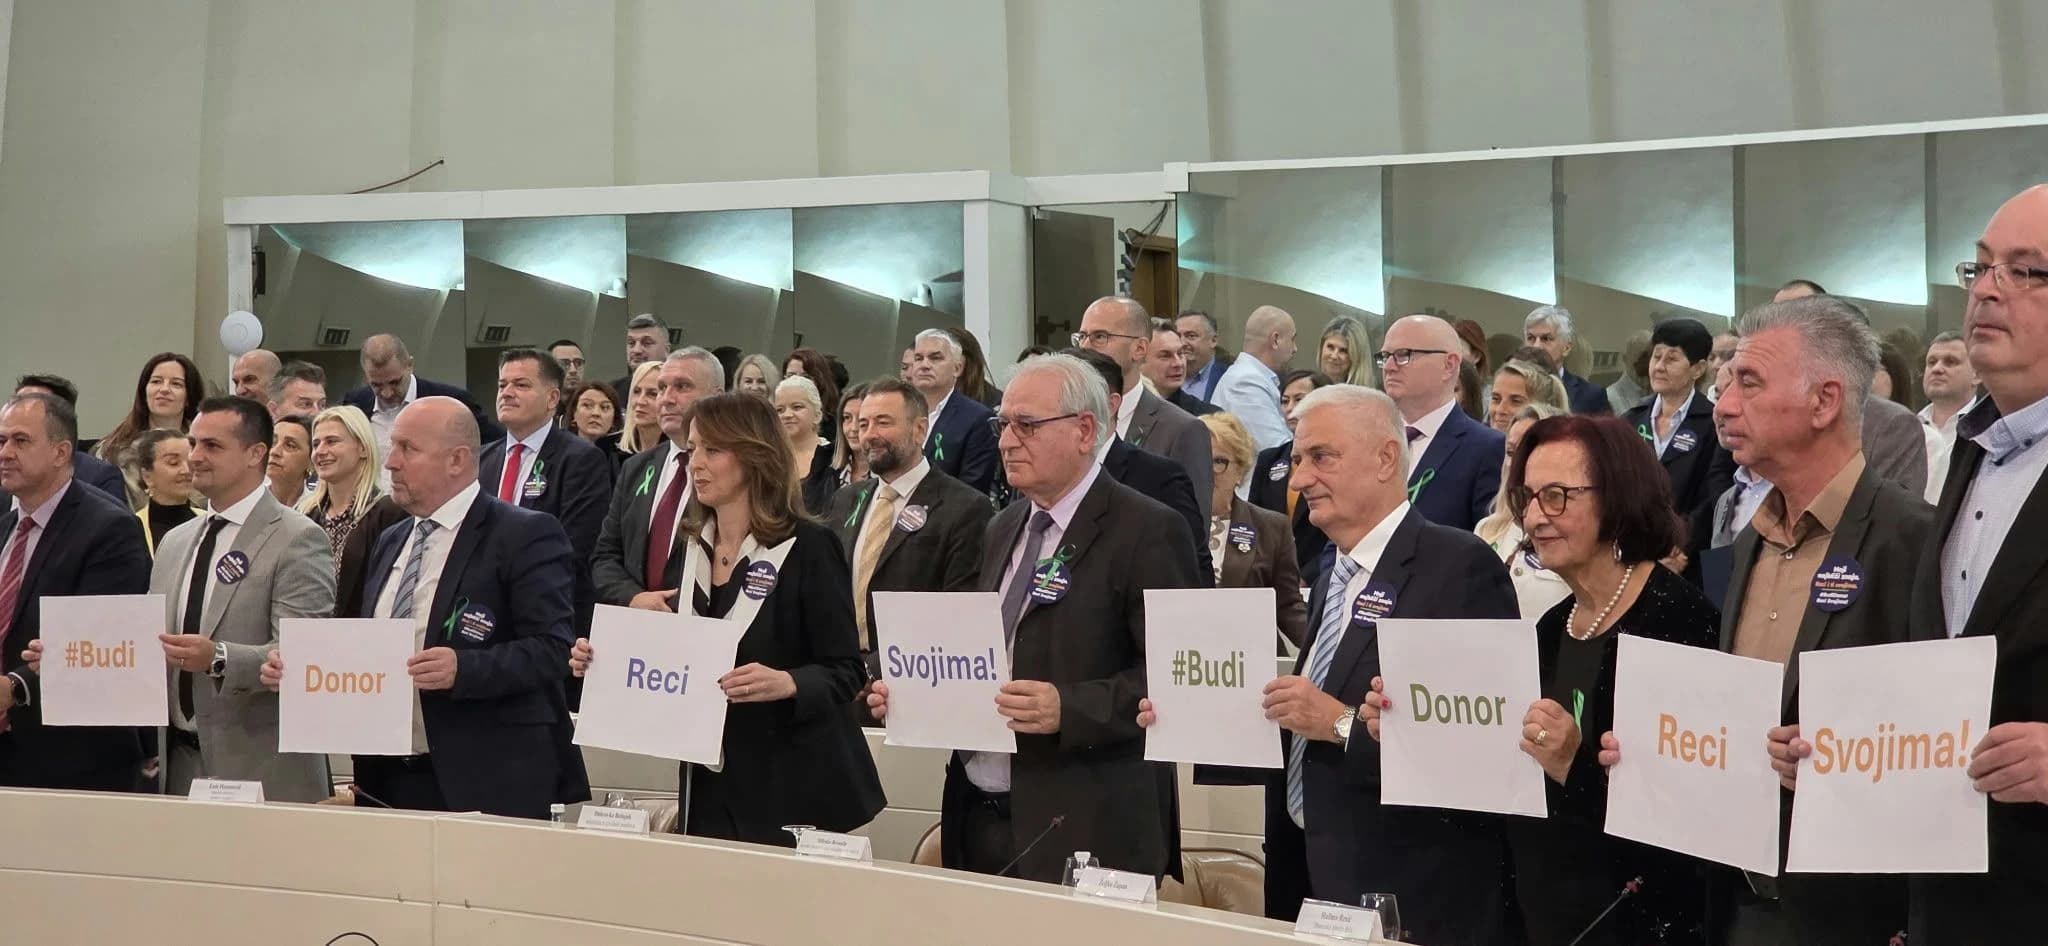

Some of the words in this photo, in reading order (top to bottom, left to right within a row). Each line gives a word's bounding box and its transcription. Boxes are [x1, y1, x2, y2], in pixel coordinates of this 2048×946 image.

[65, 640, 136, 668] #Budi
[887, 645, 998, 688] Svojima!
[1171, 649, 1245, 689] #Budi
[304, 664, 386, 694] Donor
[626, 657, 690, 696] Reci
[1409, 683, 1507, 726] Donor
[1657, 712, 1728, 771] Reci
[1812, 719, 1970, 784] Svojima!
